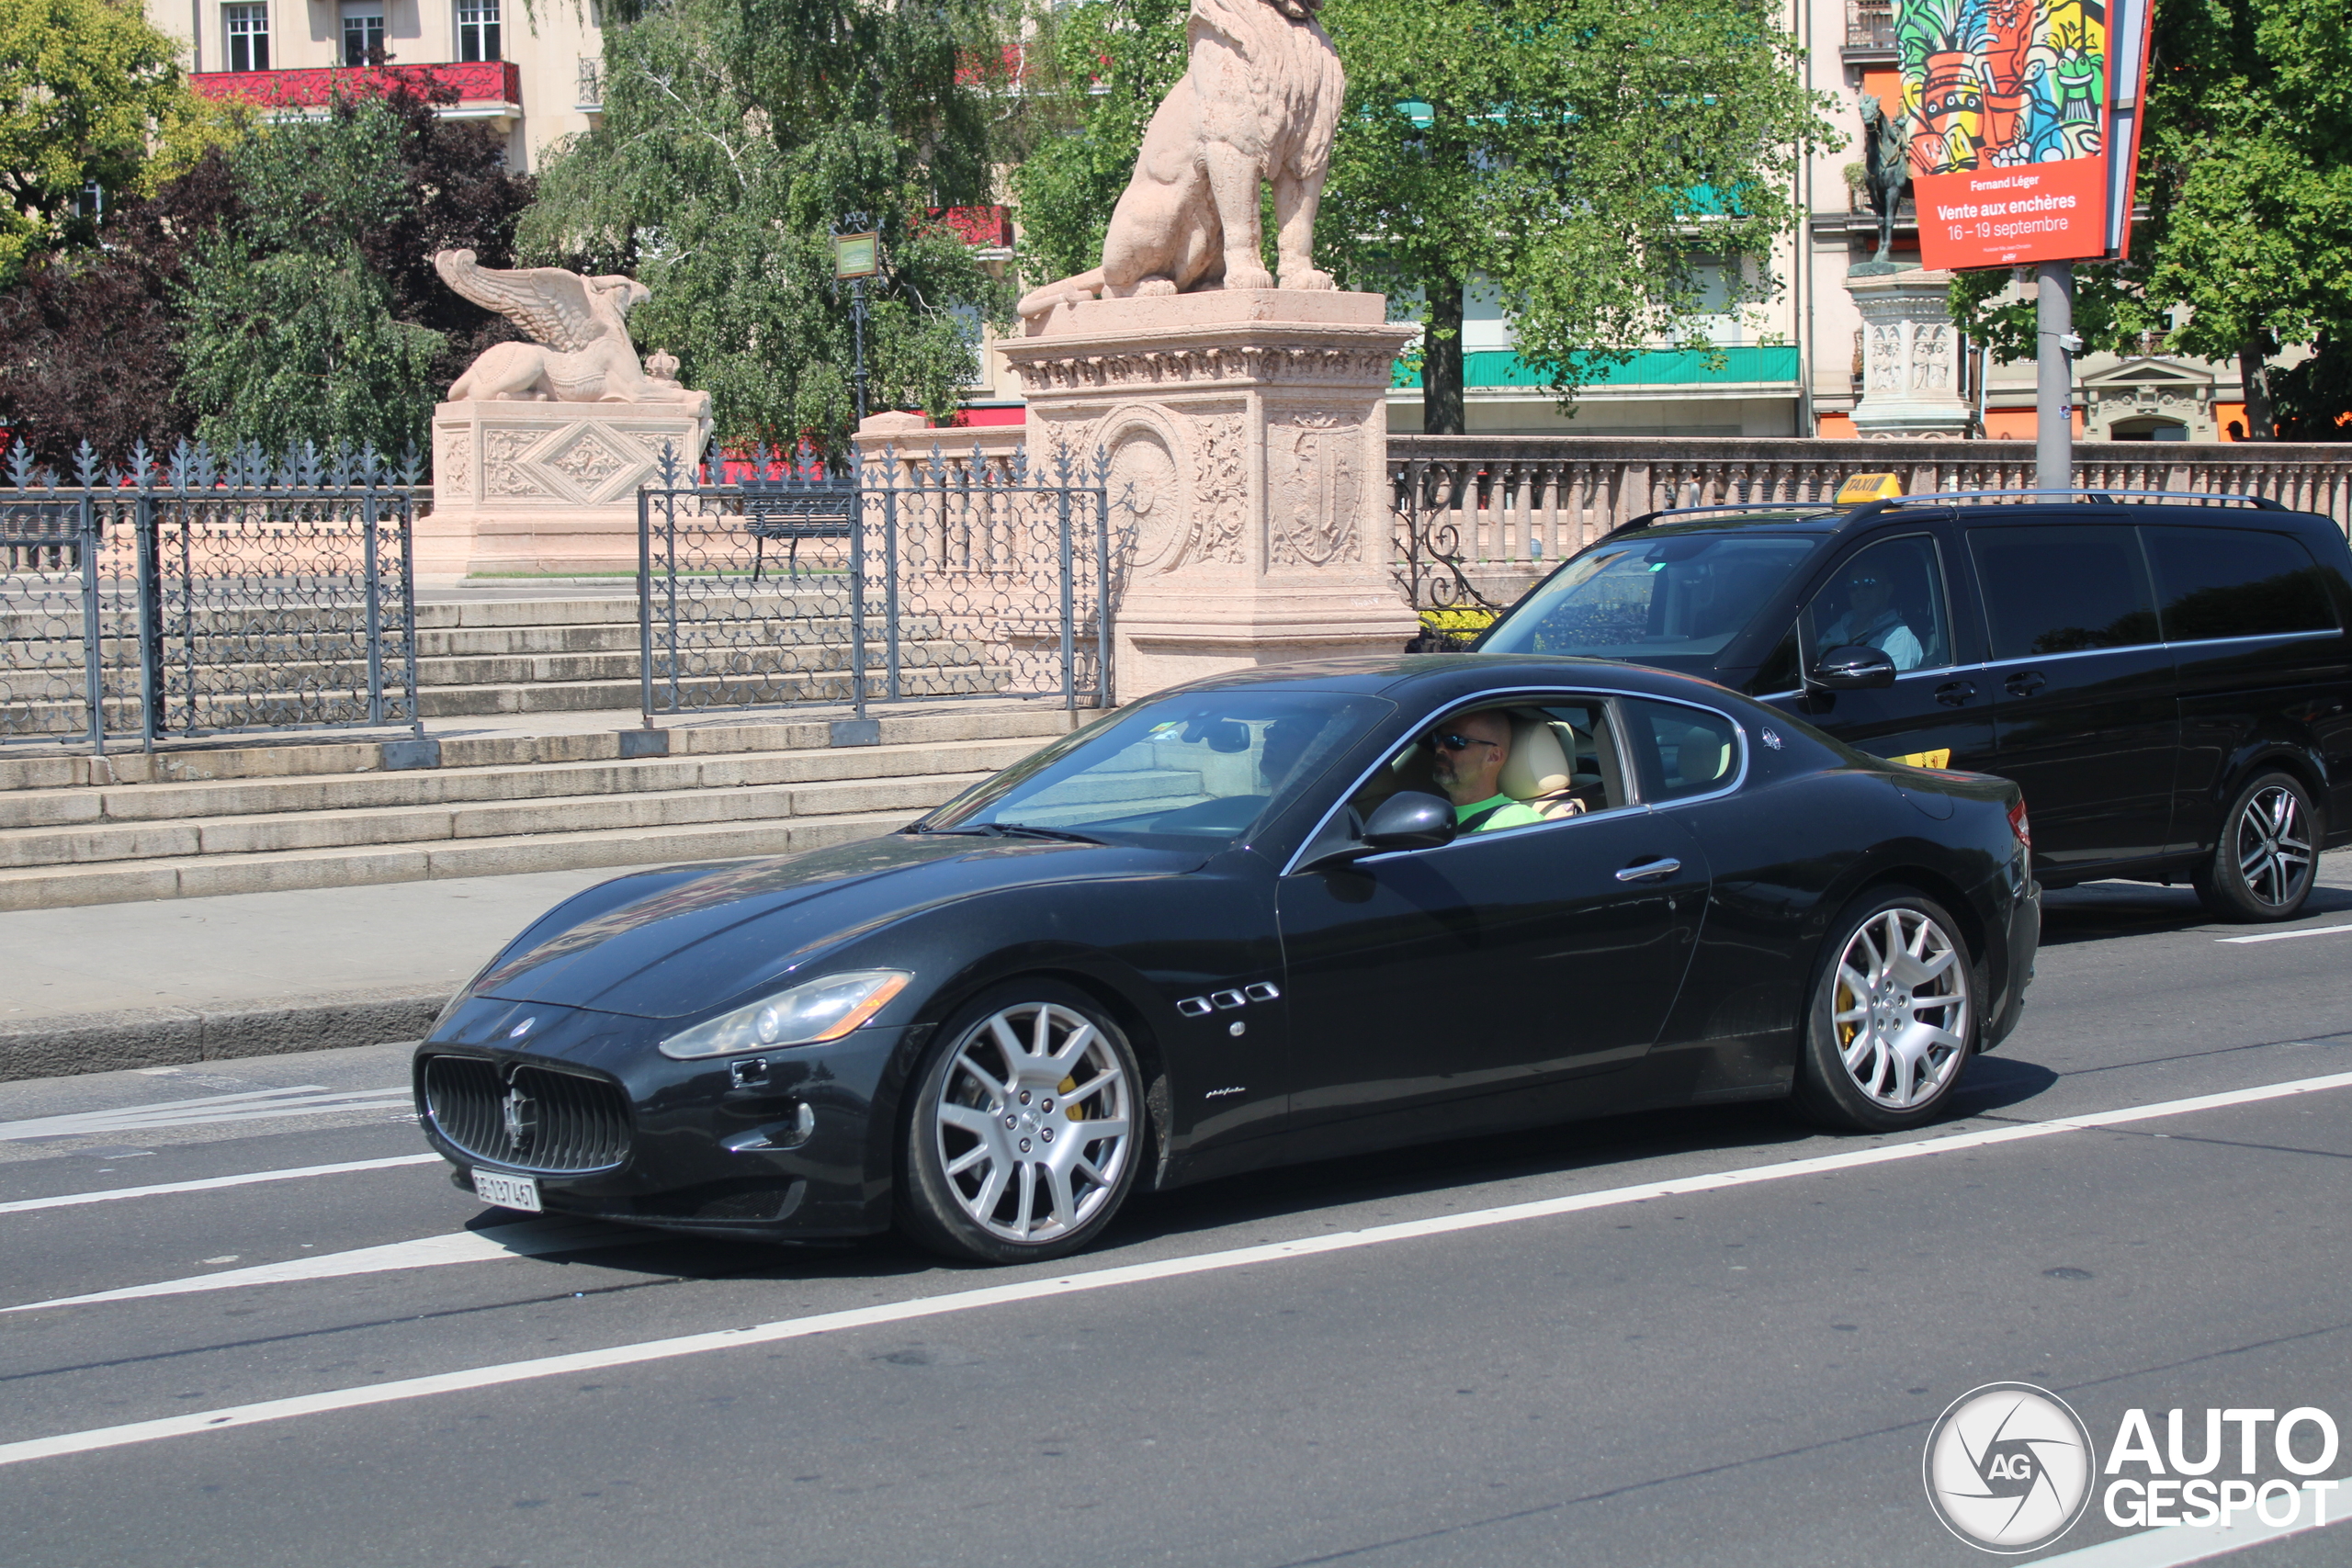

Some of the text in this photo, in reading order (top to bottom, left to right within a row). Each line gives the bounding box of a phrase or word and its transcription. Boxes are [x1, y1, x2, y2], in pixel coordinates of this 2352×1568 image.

[1970, 175, 2040, 192] Fernand Léger
[1937, 194, 2076, 221] Vente aux enchères
[1993, 216, 2069, 239] septembre
[1846, 478, 1875, 491] TAXI
